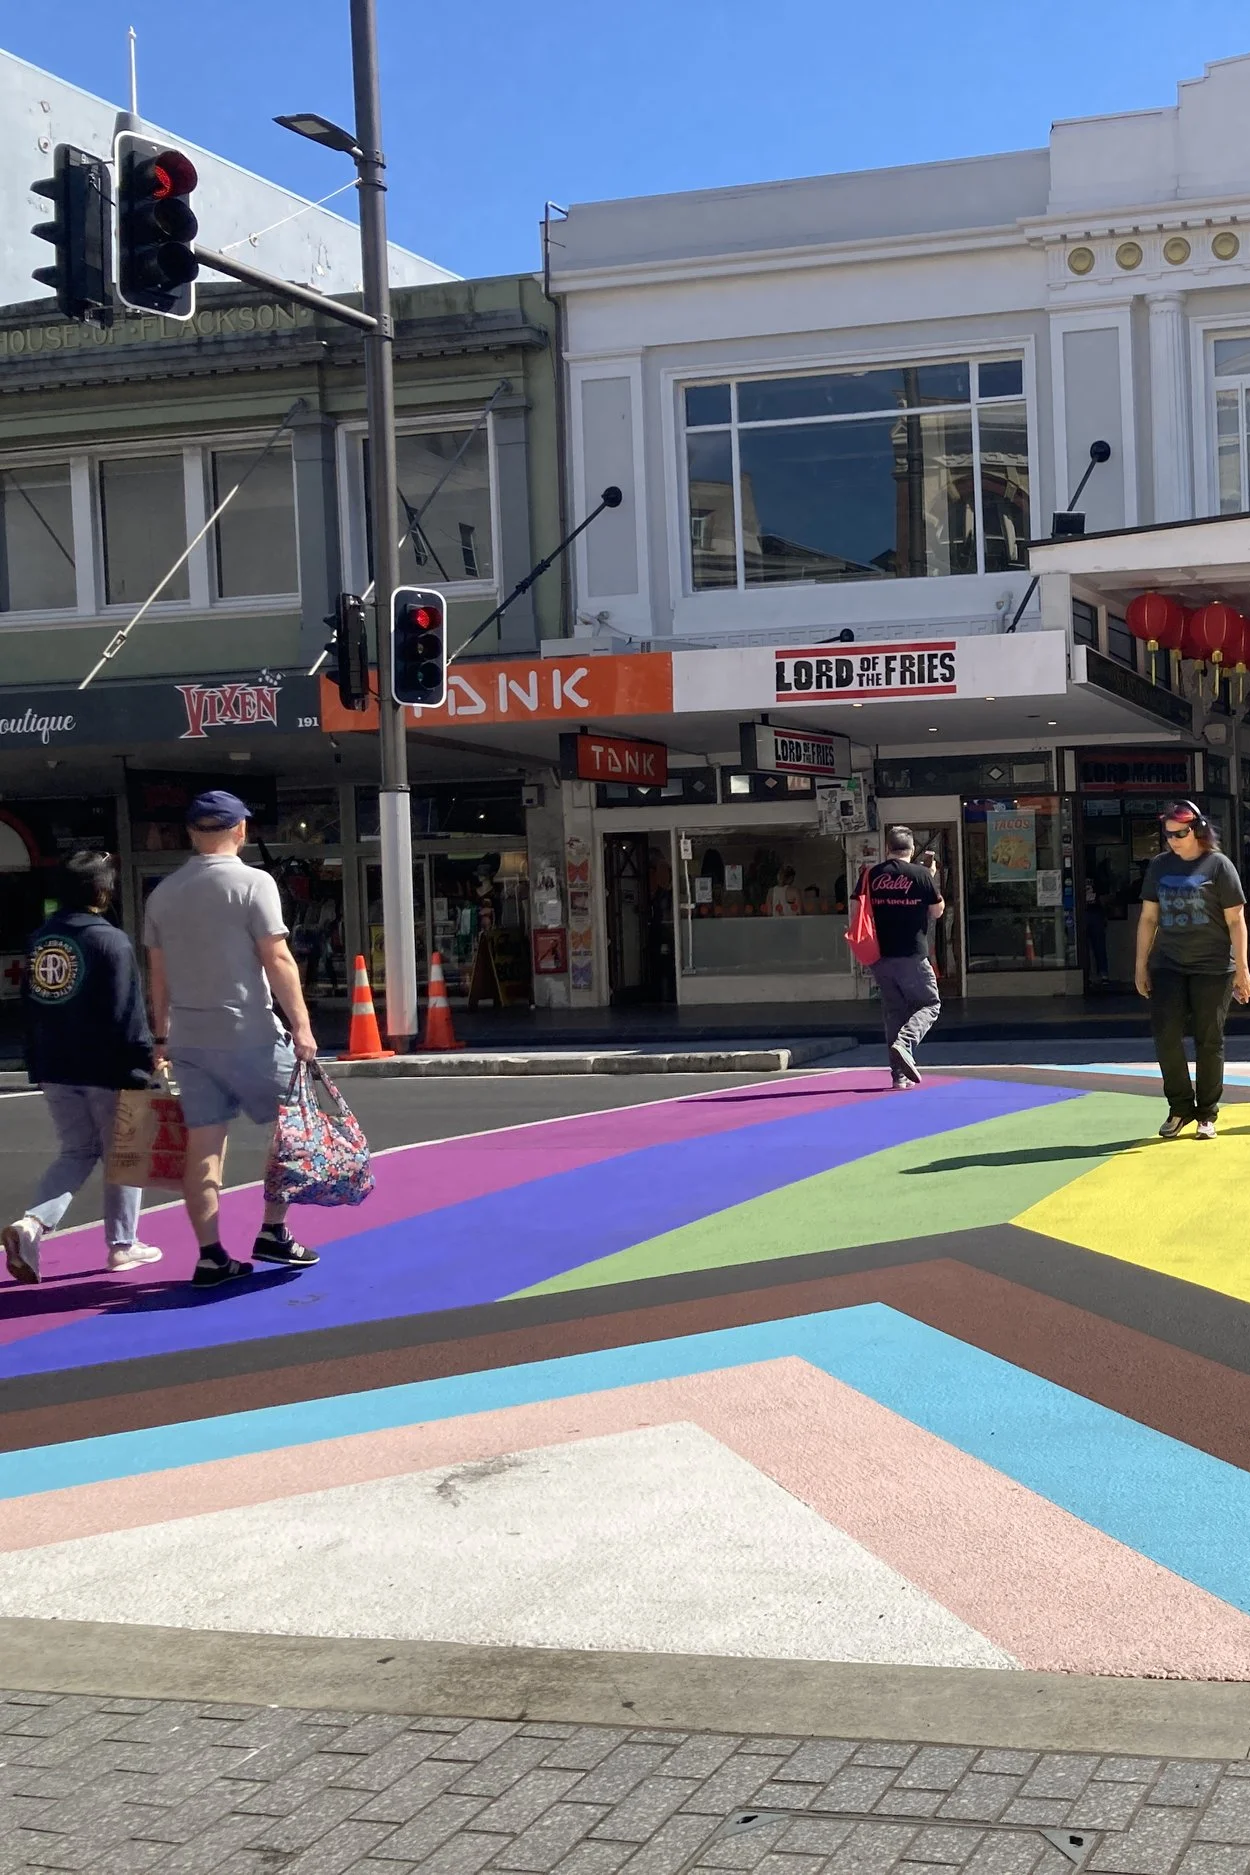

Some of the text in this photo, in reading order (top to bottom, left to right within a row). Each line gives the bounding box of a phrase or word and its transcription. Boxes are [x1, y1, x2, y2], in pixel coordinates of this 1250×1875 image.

[139, 303, 297, 341] FLACKSON
[776, 652, 955, 692] LORD OF FRIES
[856, 673, 882, 687] THE
[413, 667, 589, 718] ANK
[175, 683, 283, 738] VIXEN
[298, 717, 319, 728] 191
[591, 745, 655, 777] TANK
[774, 738, 802, 762] LORD
[811, 743, 835, 766] FRIES
[992, 818, 1031, 831] TACOS
[871, 873, 914, 894] Bally
